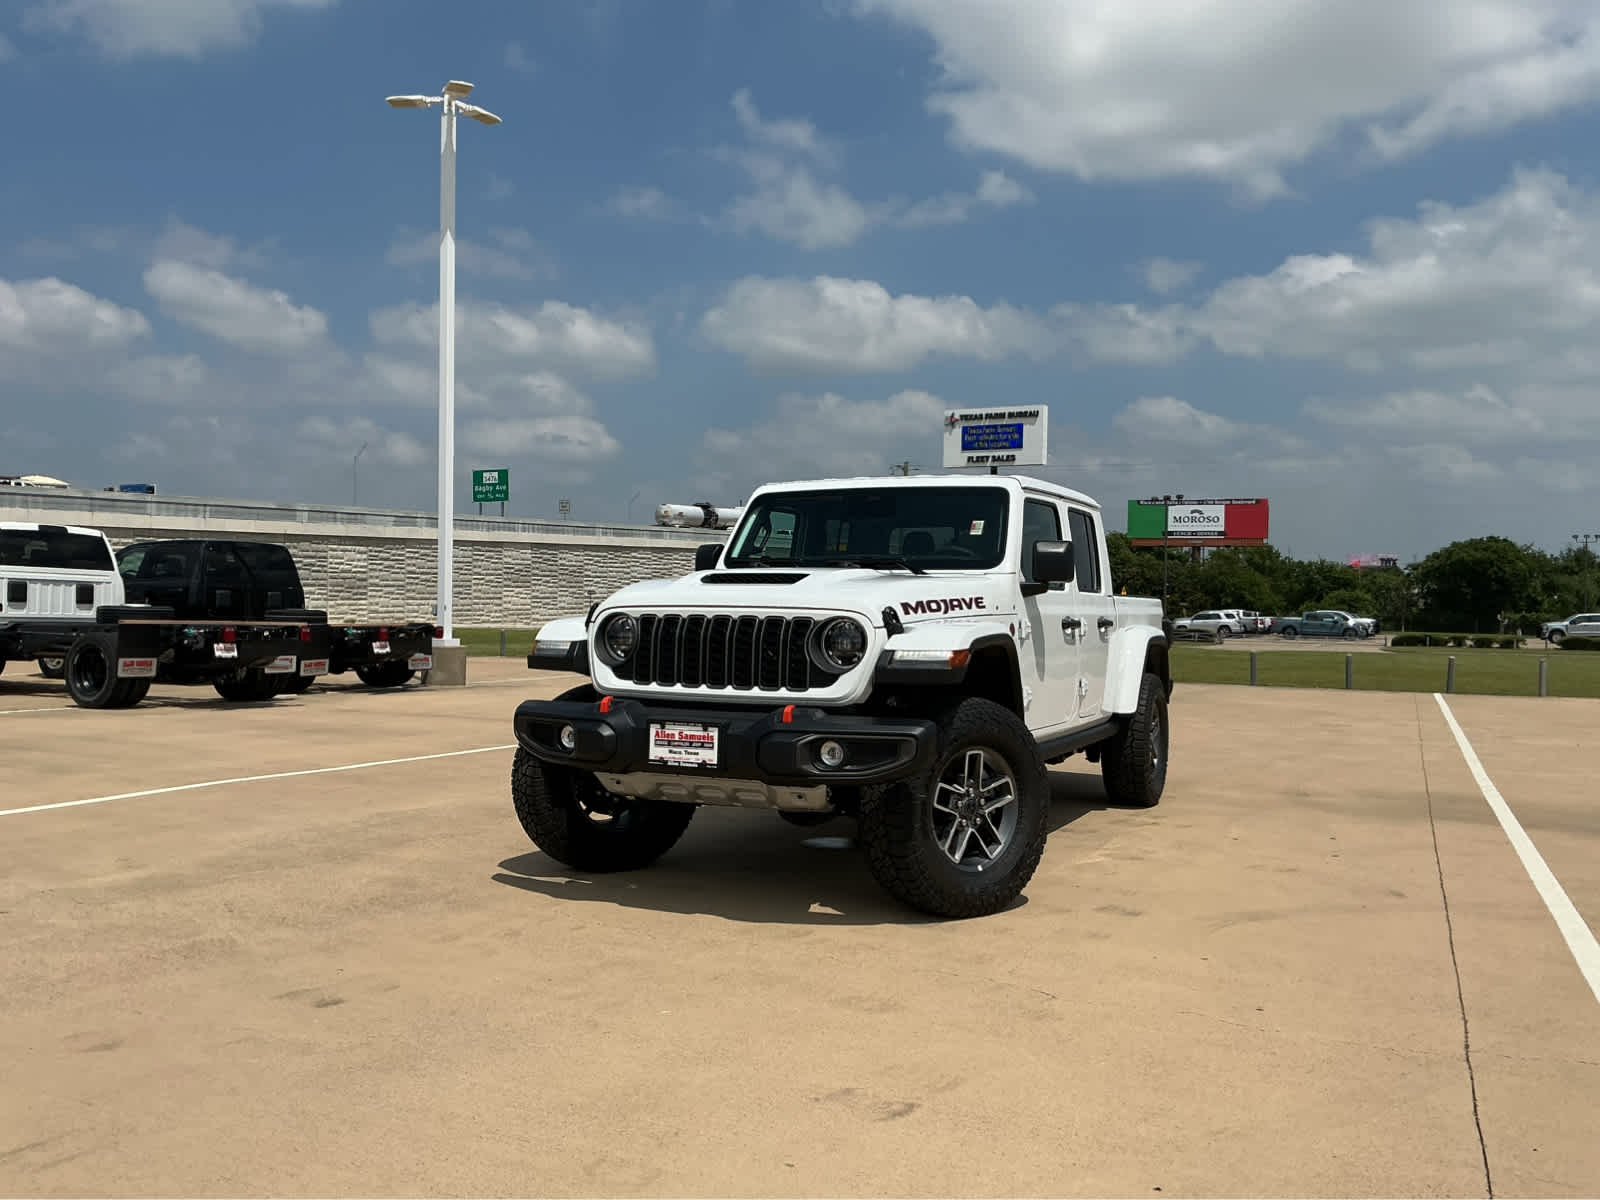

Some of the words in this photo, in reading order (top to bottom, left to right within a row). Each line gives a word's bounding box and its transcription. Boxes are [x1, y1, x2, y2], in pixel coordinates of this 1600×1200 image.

[960, 413, 983, 421] TEXAS
[984, 412, 1006, 420] FARM
[1007, 410, 1040, 419] BUREAU
[967, 455, 990, 463] FLEET
[990, 454, 1016, 463] SALES
[474, 485, 493, 493] Bagby
[1173, 515, 1220, 524] MOROSO
[900, 596, 986, 616] MOJAVE
[655, 730, 675, 739] Allen
[678, 731, 714, 741] Samuels
